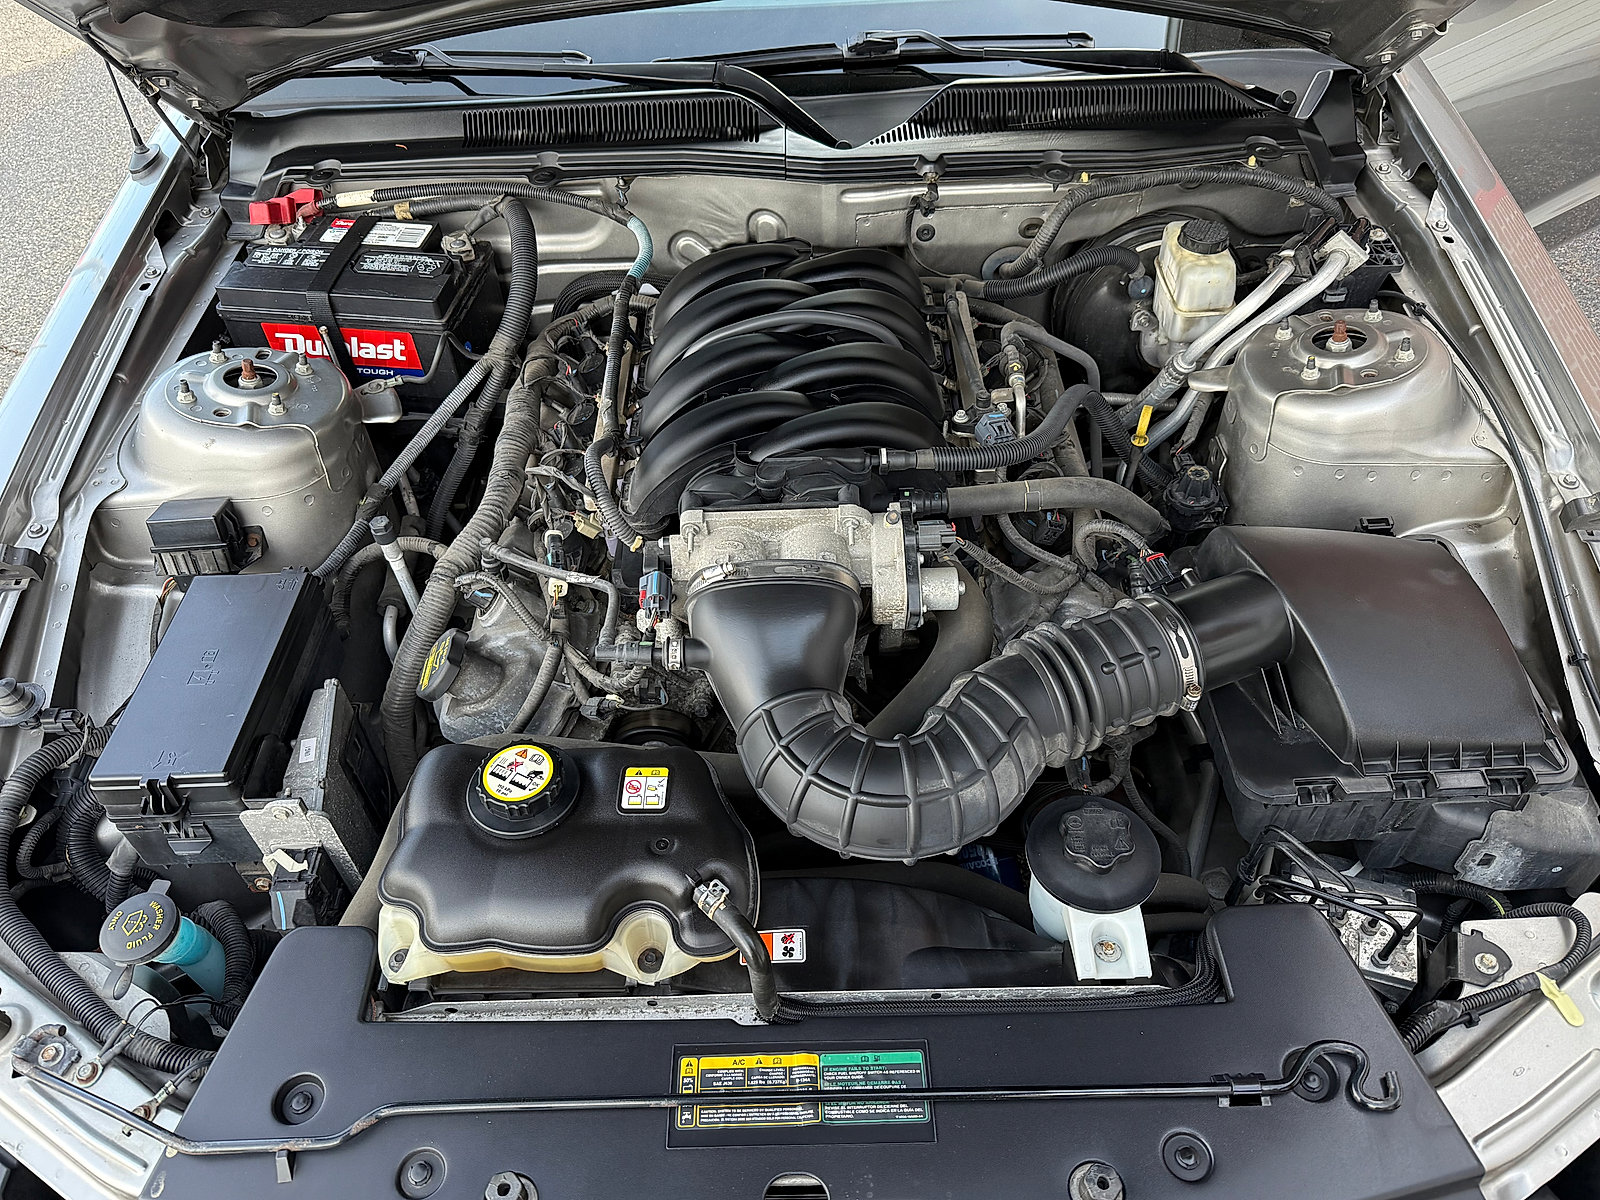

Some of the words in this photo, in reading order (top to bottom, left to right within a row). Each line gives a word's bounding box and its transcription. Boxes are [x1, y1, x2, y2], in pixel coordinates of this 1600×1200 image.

[275, 333, 407, 361] Dulast
[357, 367, 394, 376] TOUGH
[108, 911, 123, 930] ONLY
[149, 901, 163, 930] WASHER
[126, 932, 154, 949] FLUID
